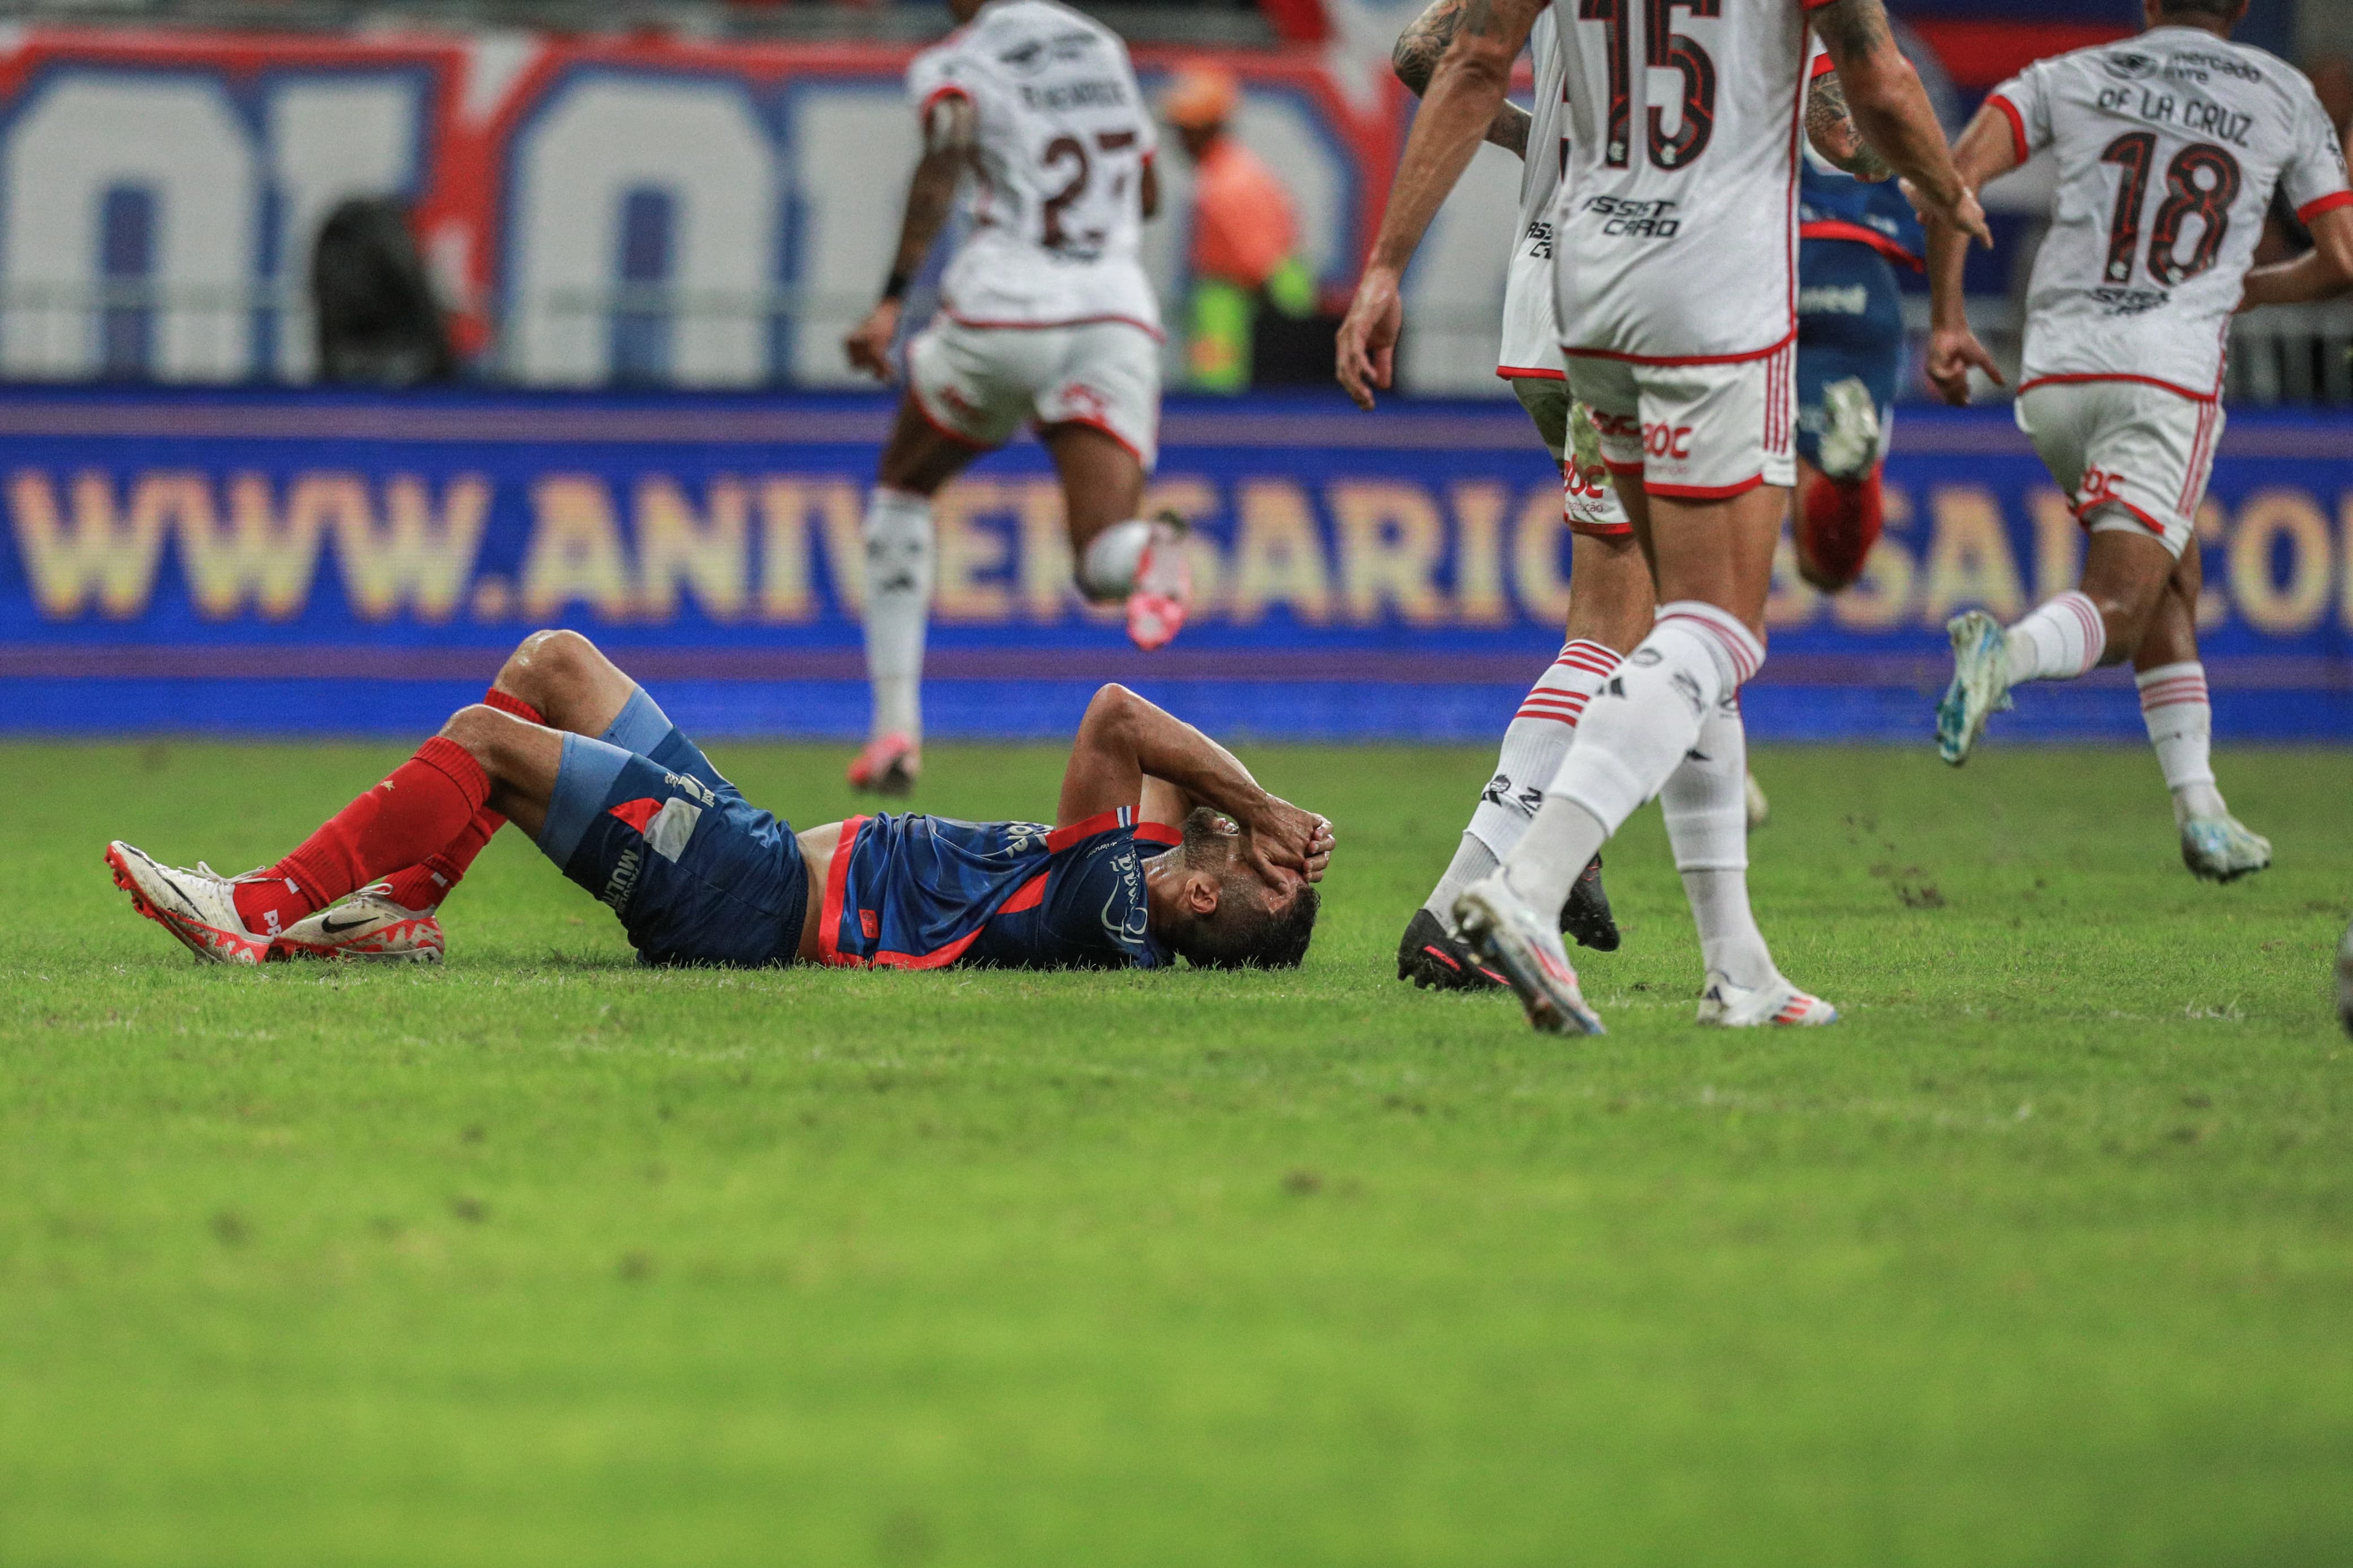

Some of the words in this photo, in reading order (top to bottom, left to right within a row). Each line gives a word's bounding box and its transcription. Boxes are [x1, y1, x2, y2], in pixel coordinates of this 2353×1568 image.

[1579, 0, 1717, 172] 15
[2141, 88, 2175, 122] LA
[2183, 98, 2253, 149] CRUZ
[2099, 131, 2241, 286] 18
